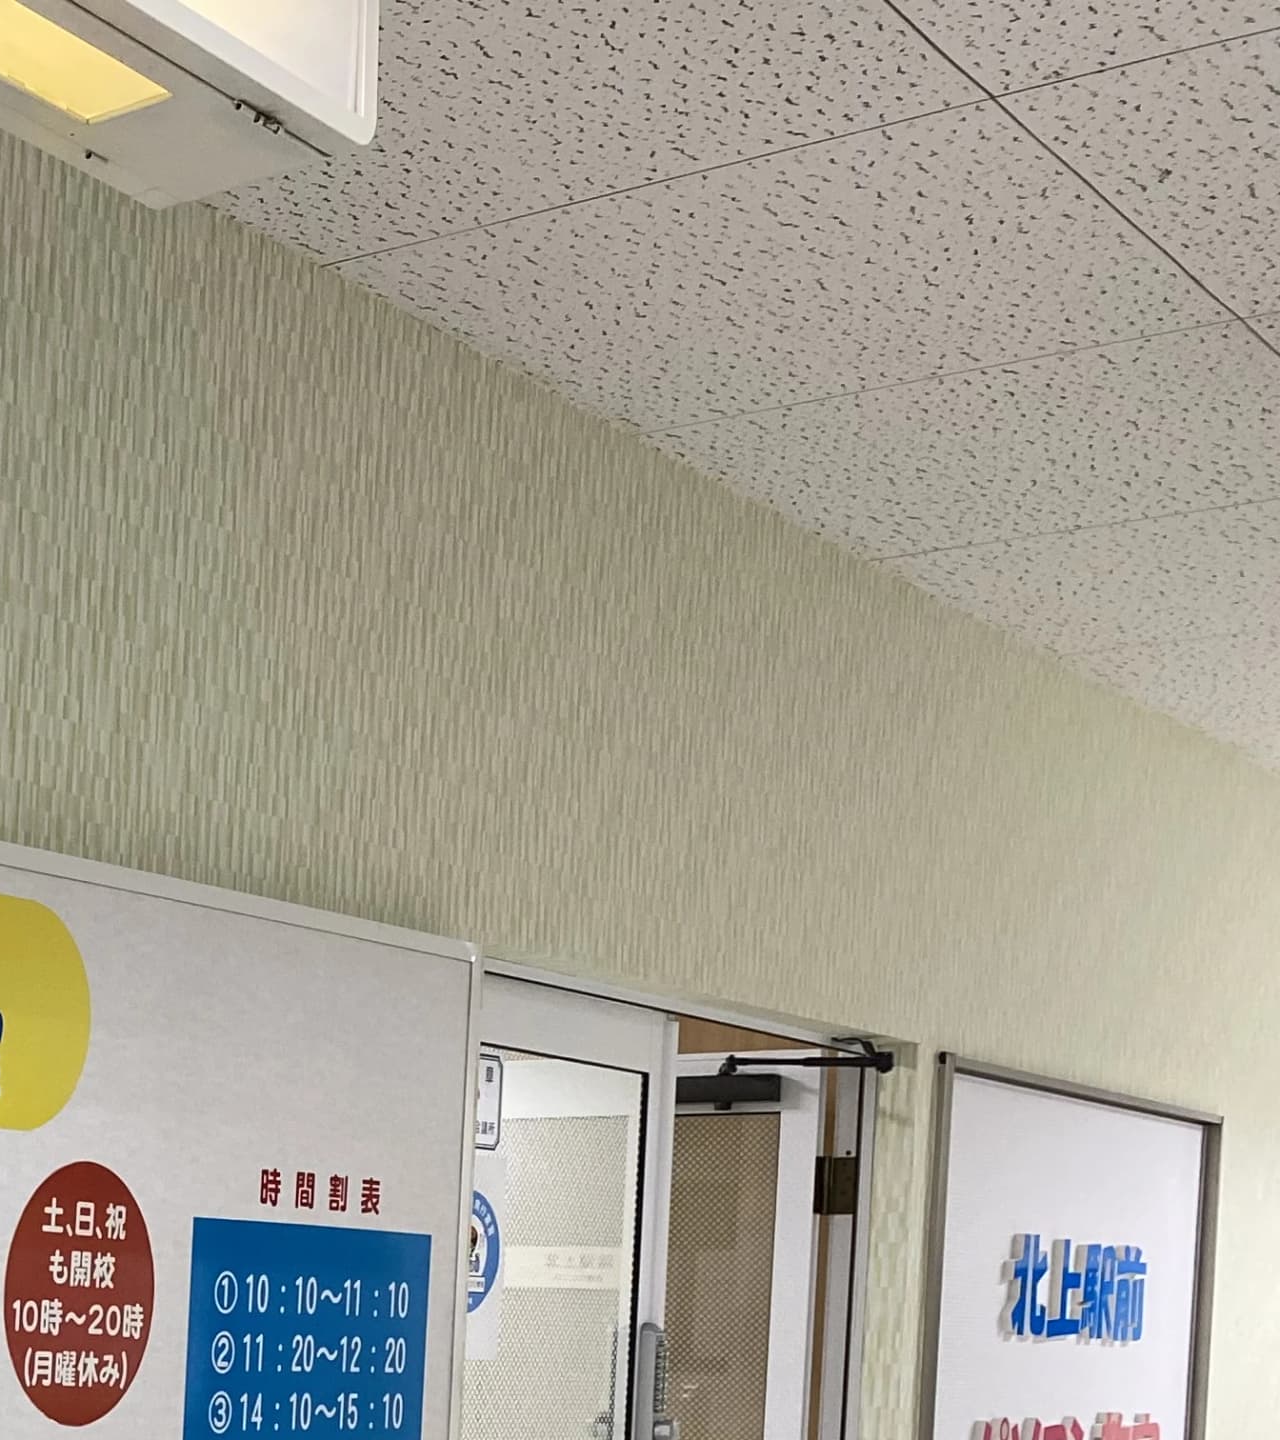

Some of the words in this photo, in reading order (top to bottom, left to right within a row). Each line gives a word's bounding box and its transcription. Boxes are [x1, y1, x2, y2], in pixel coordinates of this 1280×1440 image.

[260, 1169, 381, 1215] 時間割表
[49, 1250, 115, 1289] も開校
[1006, 1233, 1147, 1342] 北上駅前
